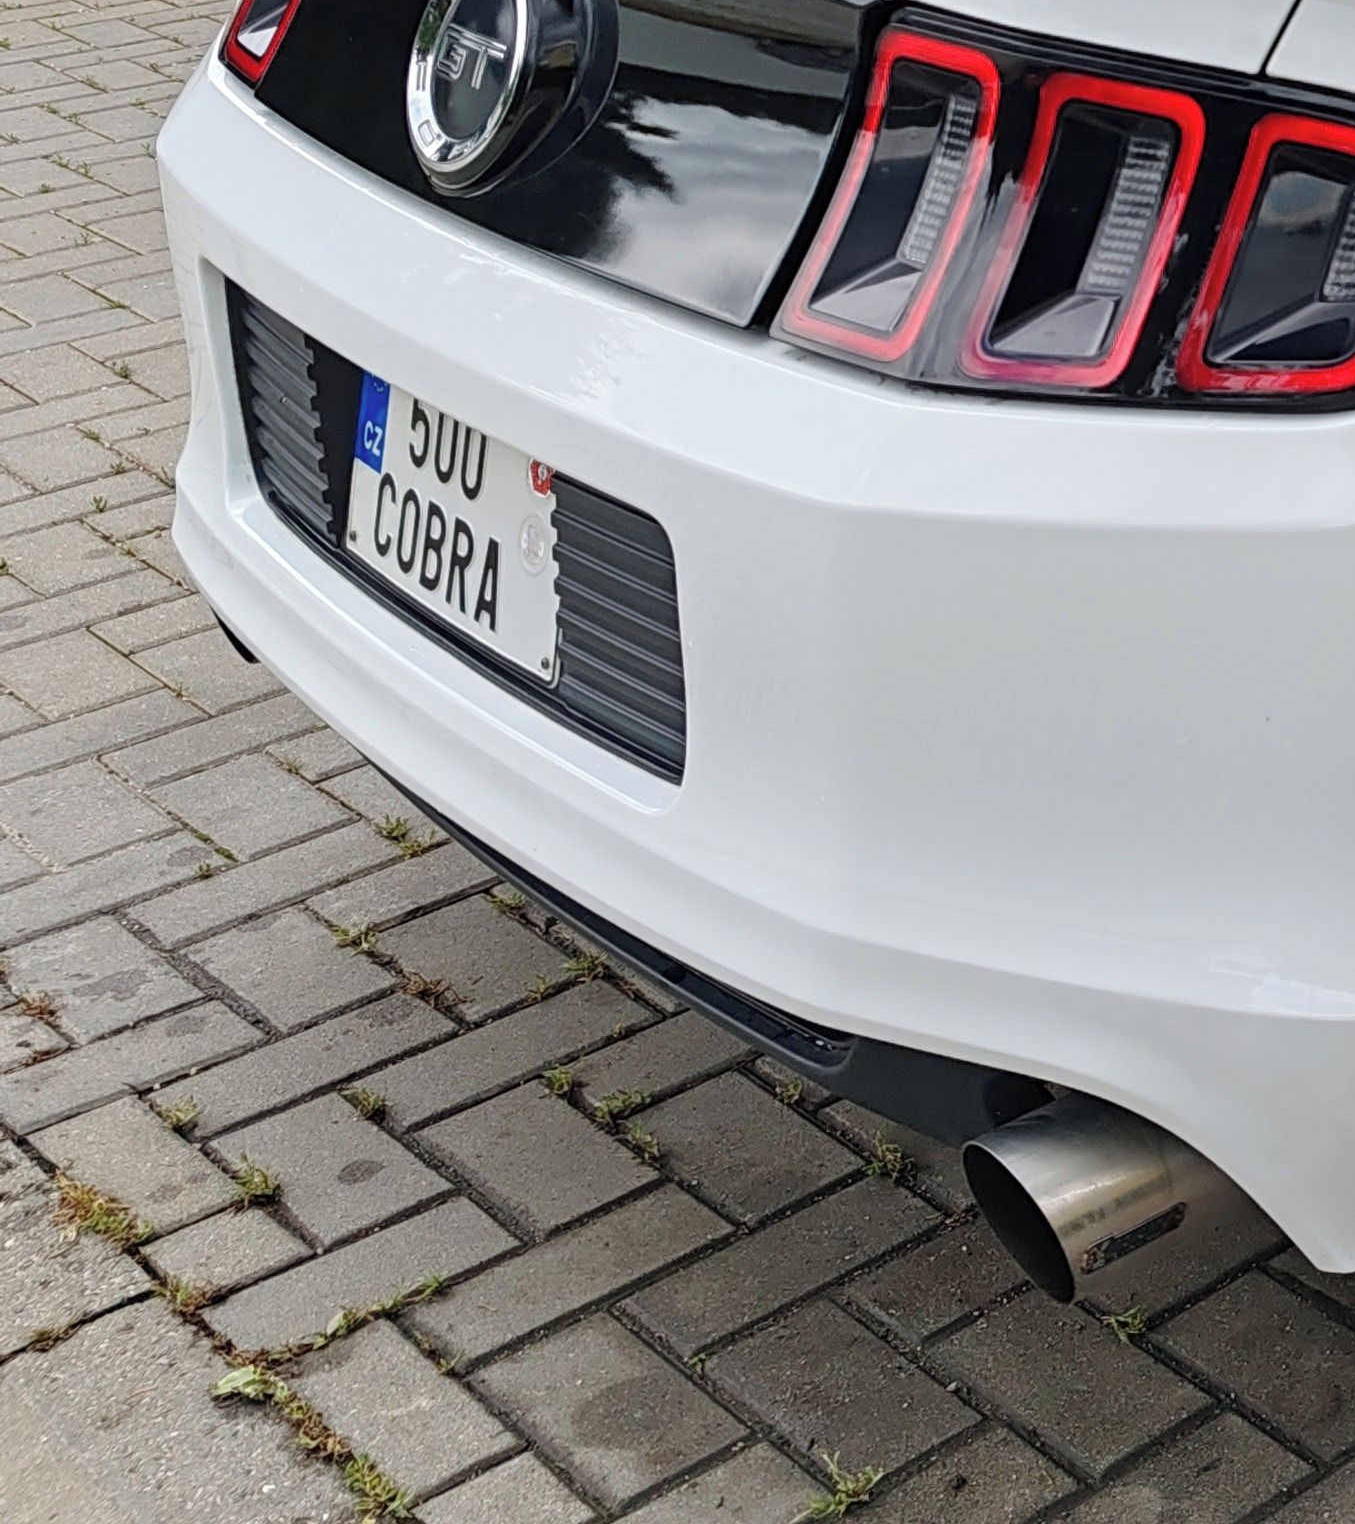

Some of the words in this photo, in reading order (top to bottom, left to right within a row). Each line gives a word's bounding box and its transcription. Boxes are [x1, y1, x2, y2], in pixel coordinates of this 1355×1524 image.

[436, 22, 508, 90] GT
[363, 420, 382, 457] CZ
[374, 472, 501, 632] COBRA
